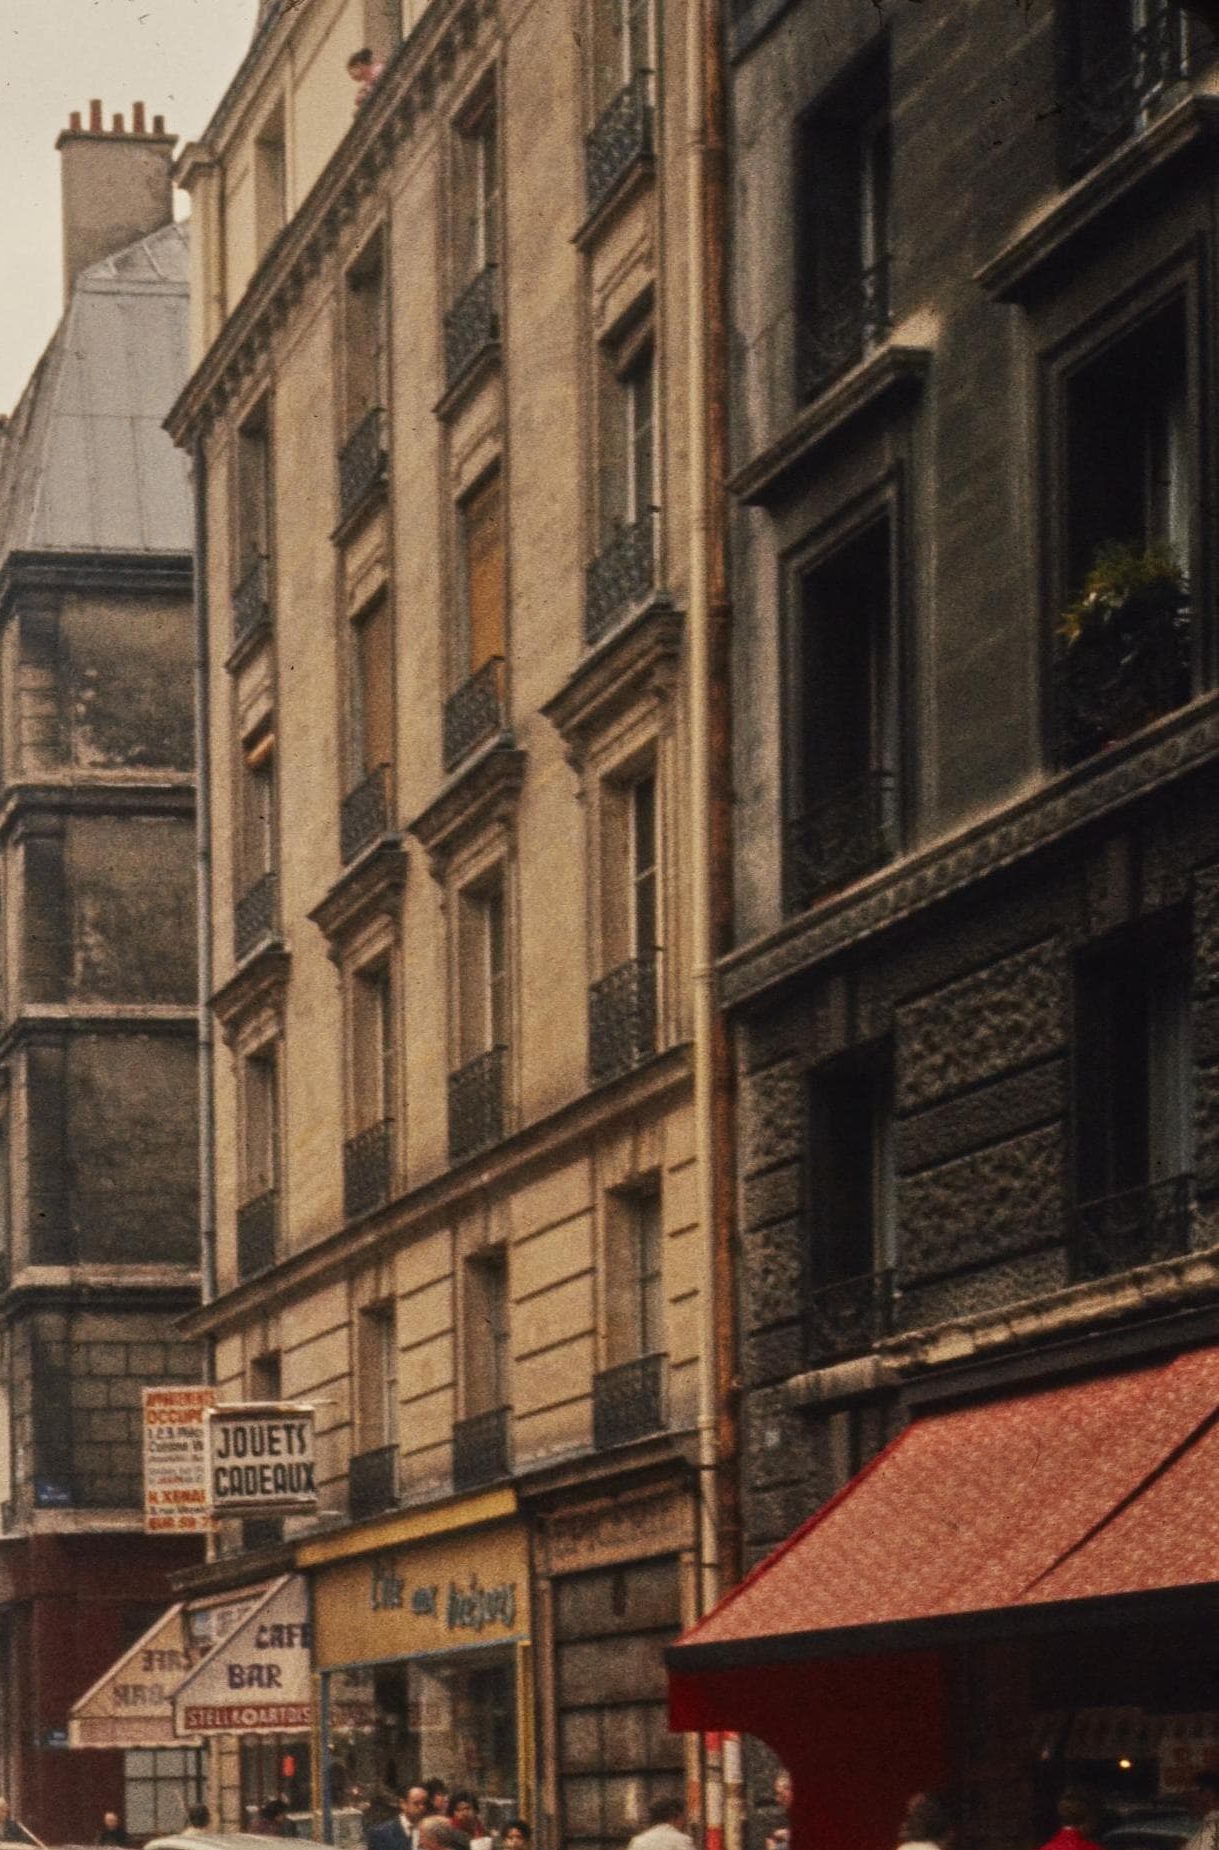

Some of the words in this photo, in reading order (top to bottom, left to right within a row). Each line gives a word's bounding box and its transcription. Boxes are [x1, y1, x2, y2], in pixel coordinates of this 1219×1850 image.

[218, 1425, 307, 1458] JOUETS
[214, 1464, 316, 1496] CADEAUX
[227, 1663, 283, 1690] BAR
